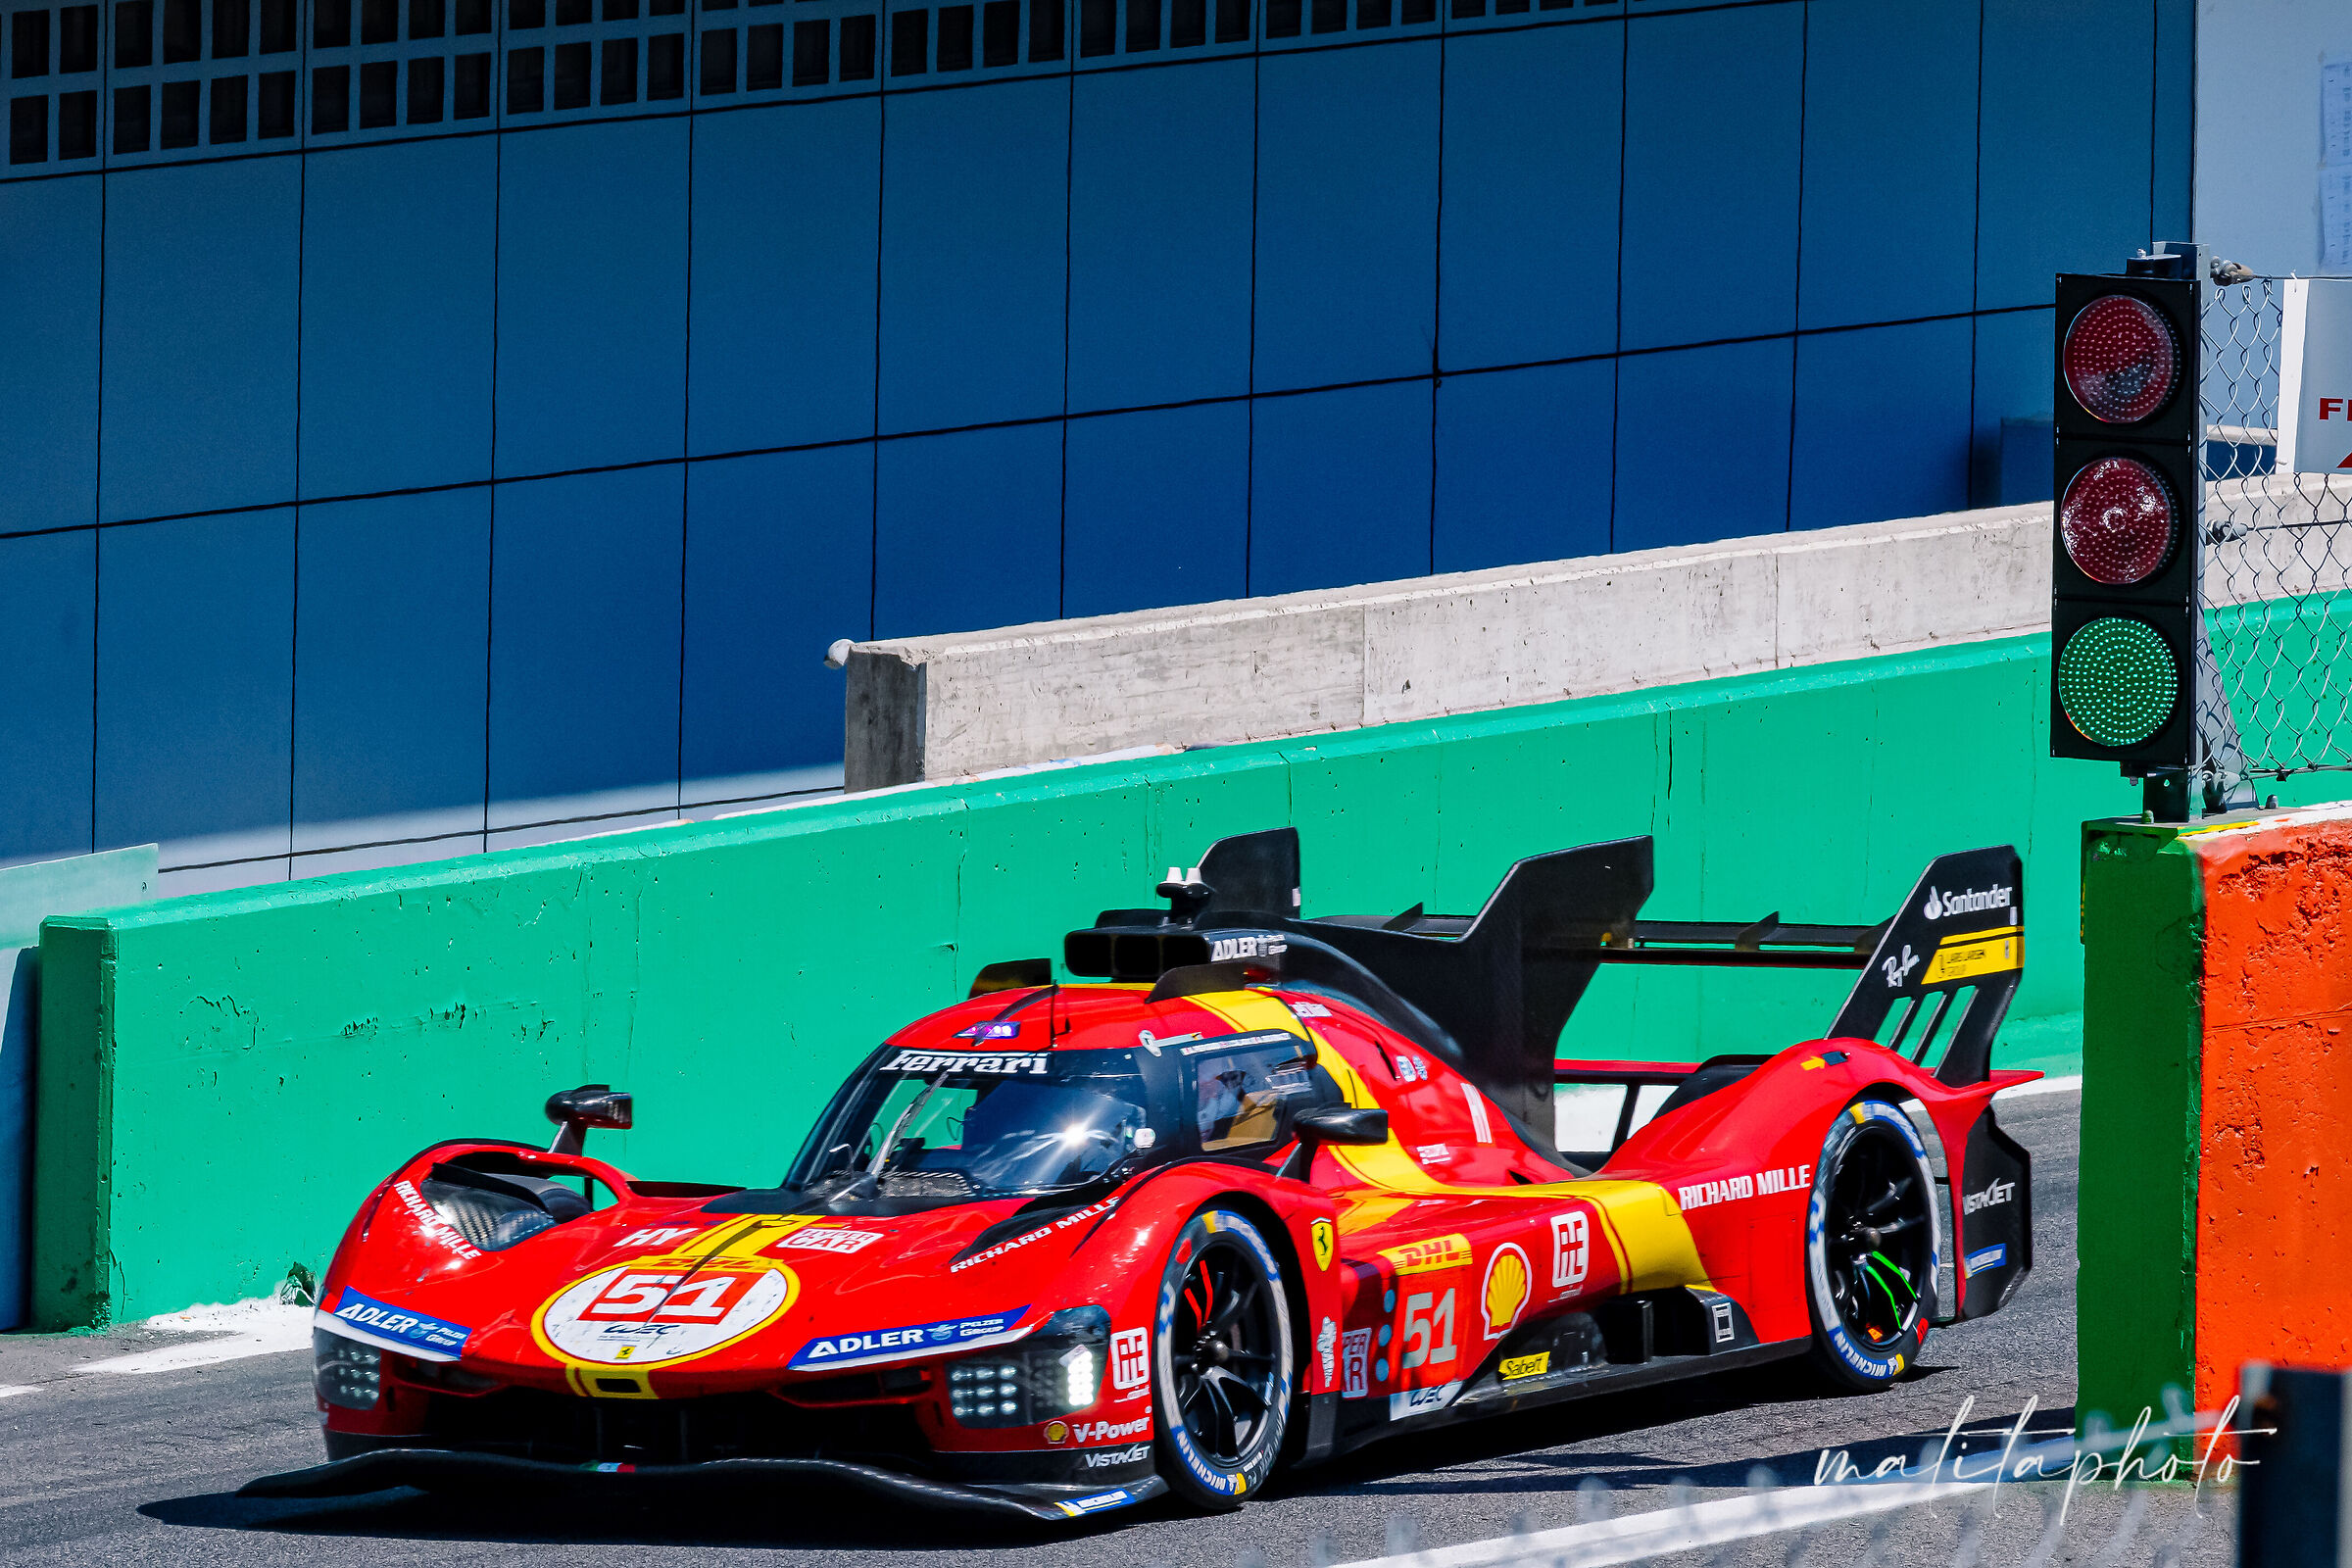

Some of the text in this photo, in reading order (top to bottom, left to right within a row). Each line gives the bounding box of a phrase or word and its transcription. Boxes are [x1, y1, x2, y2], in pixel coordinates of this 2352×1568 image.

[2319, 397, 2352, 421] F
[1942, 884, 2013, 916] Santander
[1210, 936, 1257, 962] ADLER
[879, 1050, 1052, 1075] Ferrari
[1678, 1164, 1811, 1210] RICHARD MILLE
[393, 1180, 482, 1260] RICHARD MILLE
[787, 1235, 861, 1250] CAR
[803, 1230, 875, 1241] HYPER
[950, 1196, 1121, 1273] RICHARD MILLE
[1398, 1240, 1459, 1267] DHL
[590, 1274, 737, 1317] 51
[334, 1302, 419, 1334] ADLER
[603, 1324, 681, 1335] WEC
[1402, 1288, 1457, 1370] 51
[808, 1330, 923, 1358] ADLER
[1834, 1331, 1887, 1377] MICHELIN
[1506, 1357, 1543, 1375] Sabelt
[1409, 1384, 1446, 1407] WEC
[1073, 1417, 1151, 1444] V-Power
[1177, 1429, 1227, 1491] MICHELIN
